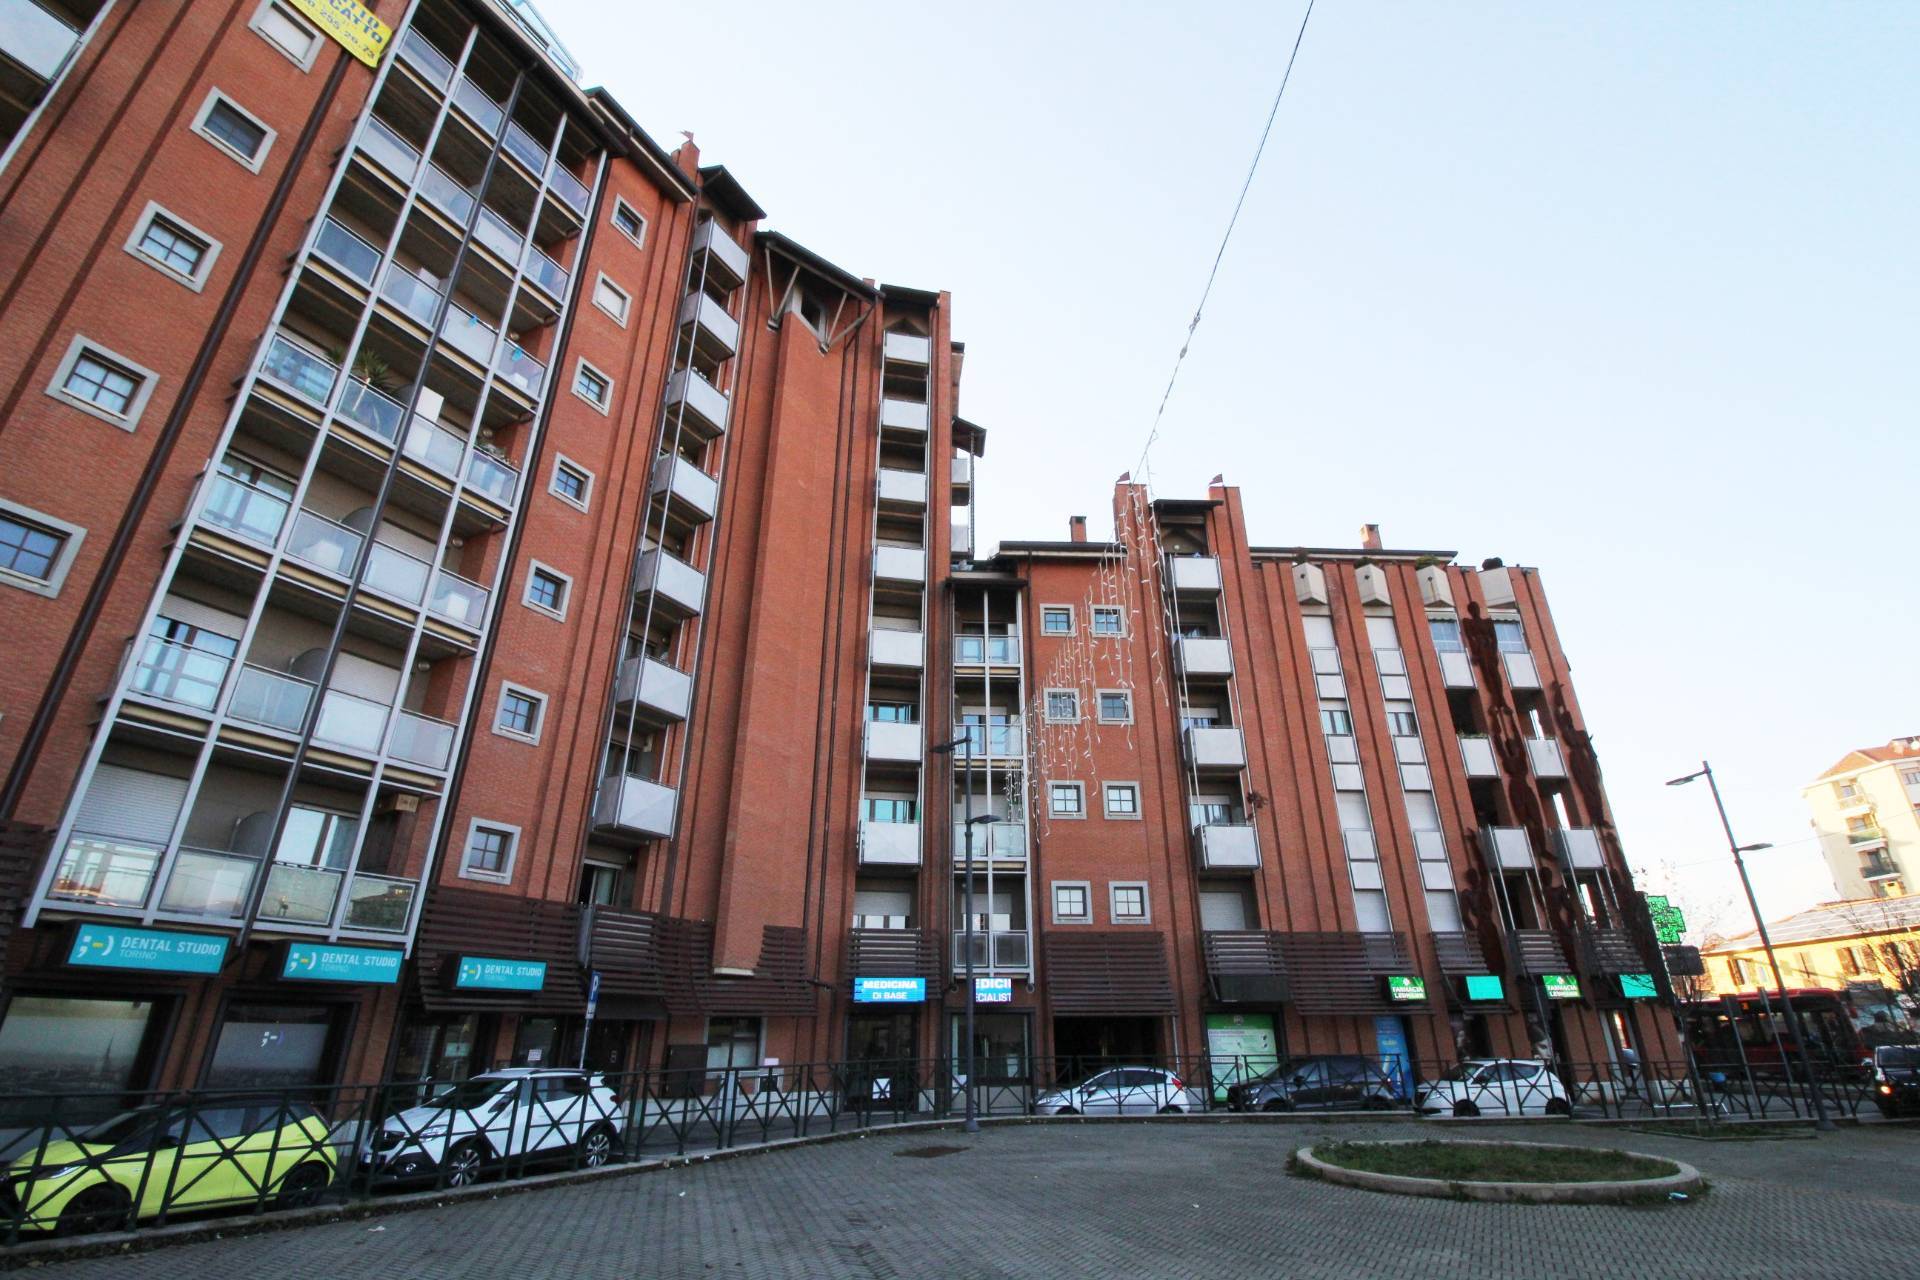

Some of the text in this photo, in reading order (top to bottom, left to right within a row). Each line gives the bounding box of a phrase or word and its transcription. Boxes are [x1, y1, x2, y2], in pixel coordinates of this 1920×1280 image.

[329, 0, 382, 43] CATTO
[121, 936, 221, 956] DENTAL STUDIO
[119, 949, 157, 960] TORINO
[321, 953, 397, 967] DENTAL STUDIO
[484, 964, 542, 977] DENTAL STUDIO
[863, 980, 918, 989] MEDICINA
[872, 992, 908, 1000] DI BASE
